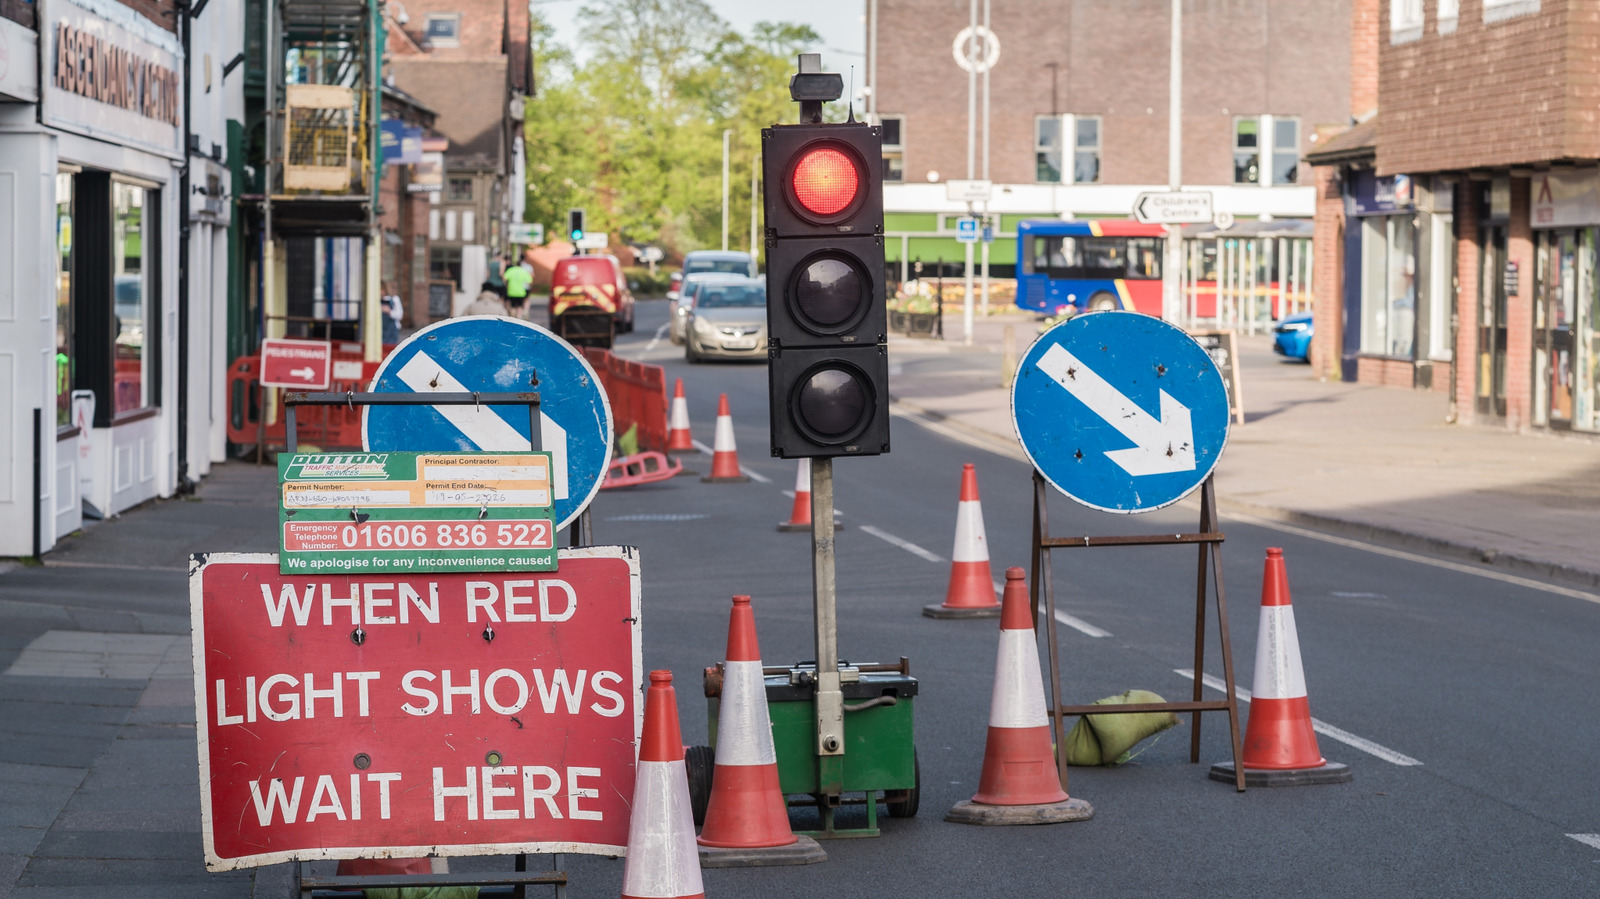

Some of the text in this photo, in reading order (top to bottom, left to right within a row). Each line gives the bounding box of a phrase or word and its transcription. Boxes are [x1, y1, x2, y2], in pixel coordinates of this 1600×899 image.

[56, 22, 140, 111] ASCENDANCY
[267, 346, 326, 360] PEDESTRIANS
[424, 458, 457, 466] Principal
[425, 482, 487, 490] Permit End Date:
[290, 524, 338, 533] Emergency
[342, 523, 547, 547] 01606 836 522
[295, 533, 338, 541] Telephone
[301, 542, 338, 550] Number:
[287, 555, 551, 570] We apologise for any inconvenience caused
[261, 579, 577, 627] WHEN RED
[216, 669, 626, 726] LIGHT SHOWS
[249, 766, 603, 827] WAIT HERE
